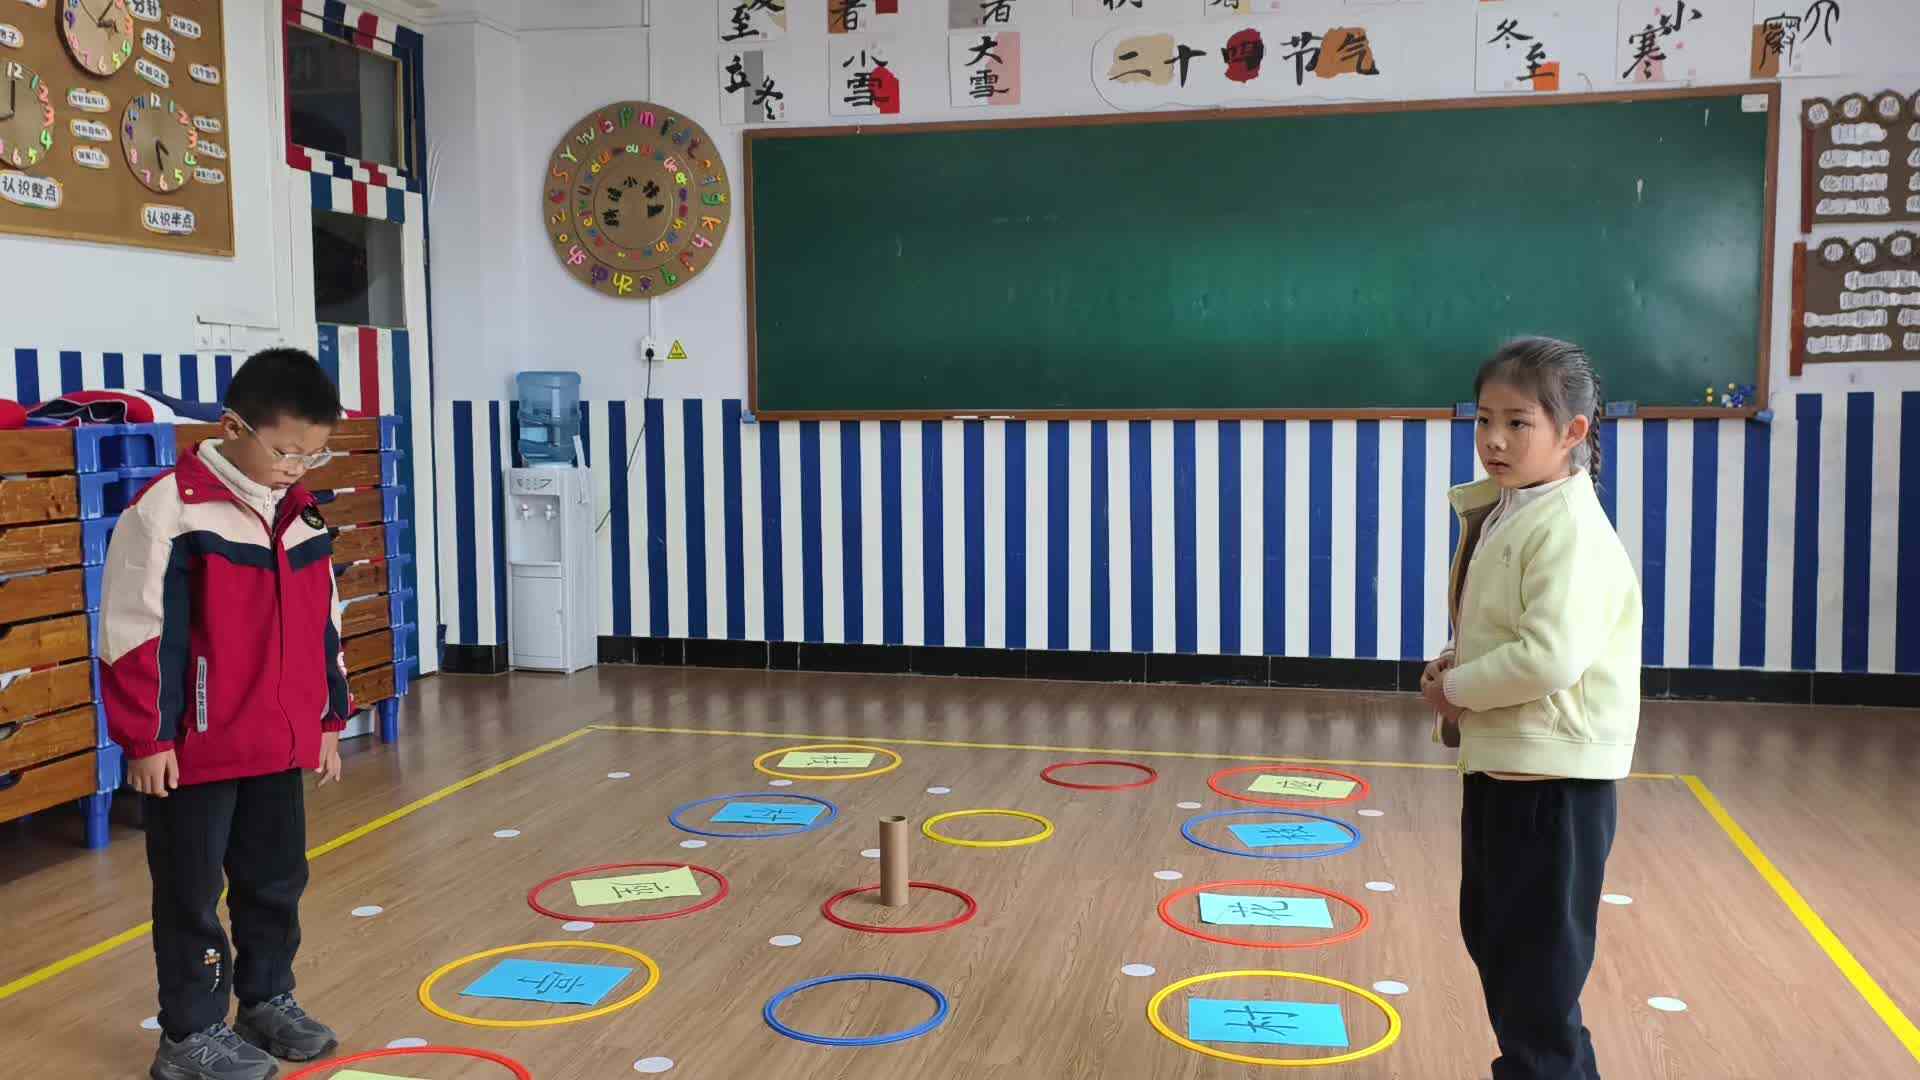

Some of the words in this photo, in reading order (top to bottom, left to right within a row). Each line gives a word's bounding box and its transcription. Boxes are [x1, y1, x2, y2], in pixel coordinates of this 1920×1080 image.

[145, 32, 172, 57] 时针
[1488, 18, 1555, 81] 冬至
[1622, 0, 1702, 79] 小寒
[7, 61, 24, 80] 12
[965, 36, 1010, 99] 大雪
[1109, 31, 1380, 88] 二十四节气
[724, 55, 783, 121] 立冬
[842, 50, 890, 107] 小雪
[41, 129, 53, 150] 4
[2, 175, 57, 202] 认识整点
[159, 174, 168, 191] 6
[174, 168, 184, 185] 5
[147, 208, 193, 229] 认识半点
[609, 881, 670, 899] 座
[1227, 900, 1294, 920] 花
[516, 970, 585, 995] 亭
[1223, 1005, 1300, 1038] 村
